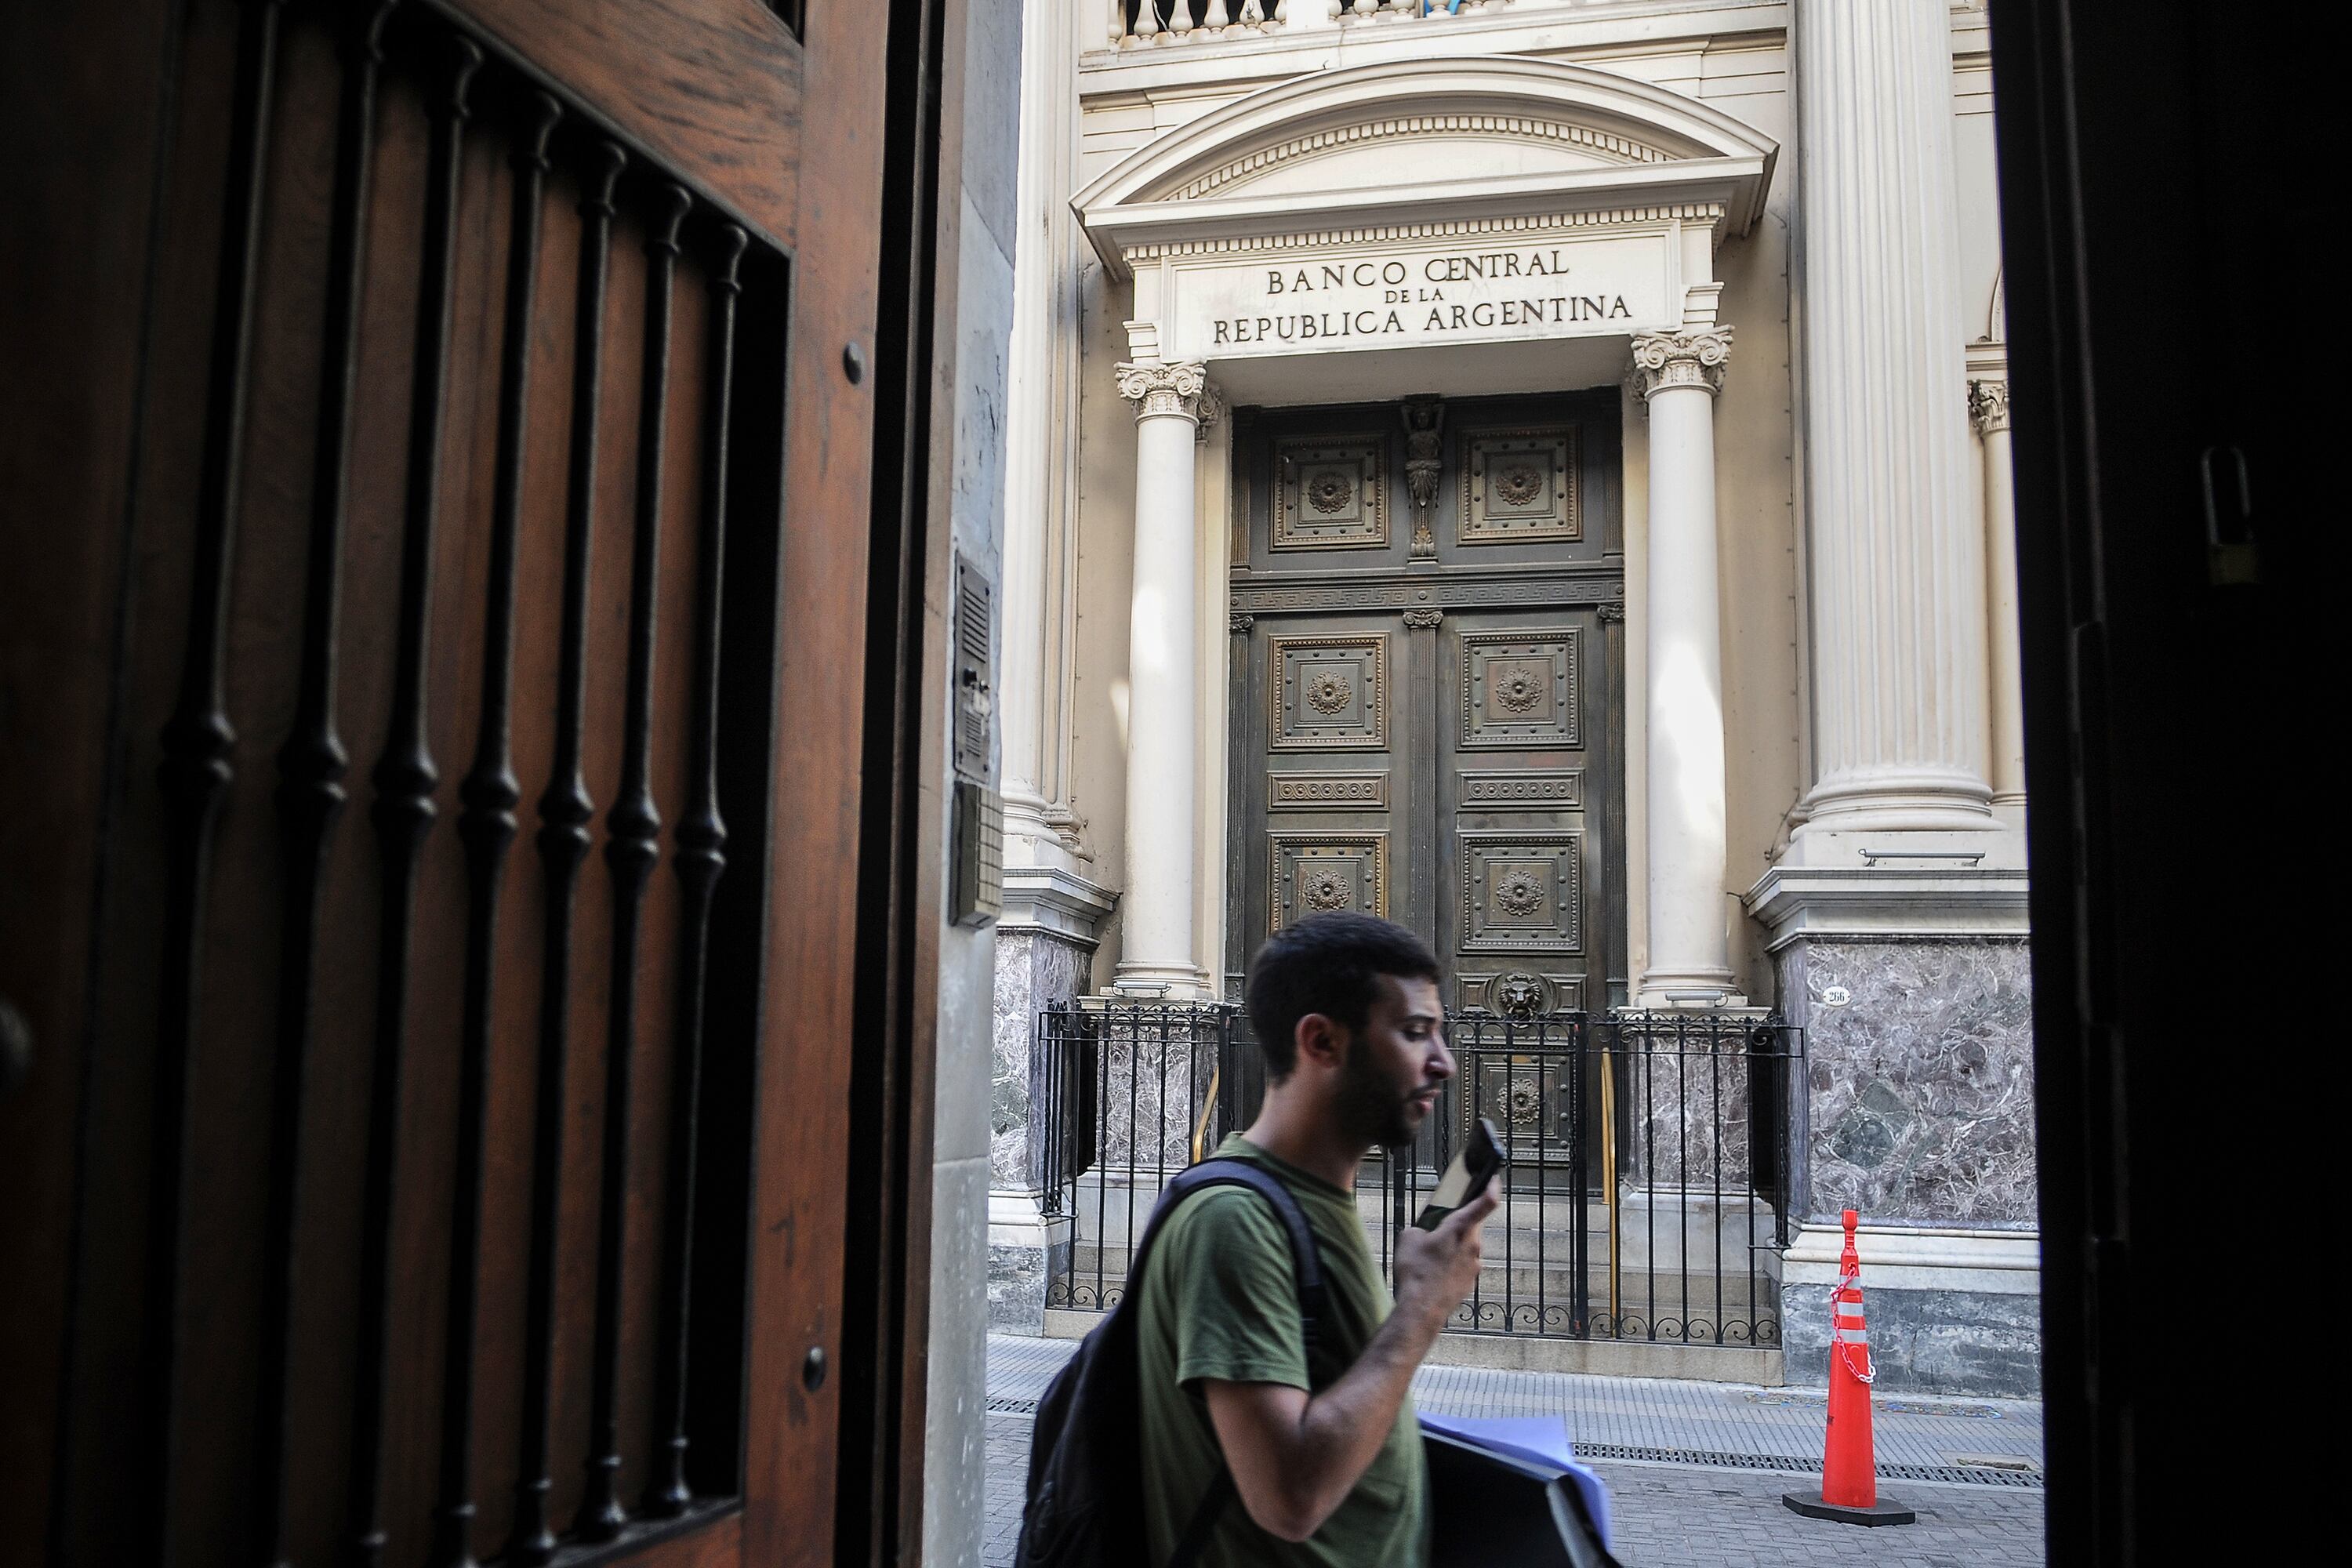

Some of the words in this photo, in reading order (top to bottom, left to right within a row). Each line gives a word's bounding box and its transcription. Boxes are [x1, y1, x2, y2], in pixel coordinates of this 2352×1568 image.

[1267, 261, 1406, 295] BANCO
[1425, 250, 1570, 283] CENTRAL
[1385, 289, 1410, 304] DE
[1420, 288, 1444, 303] LA
[1214, 310, 1405, 344] REPUBLICA
[1424, 295, 1632, 331] ARGENTINA
[1829, 992, 1845, 1002] 266
